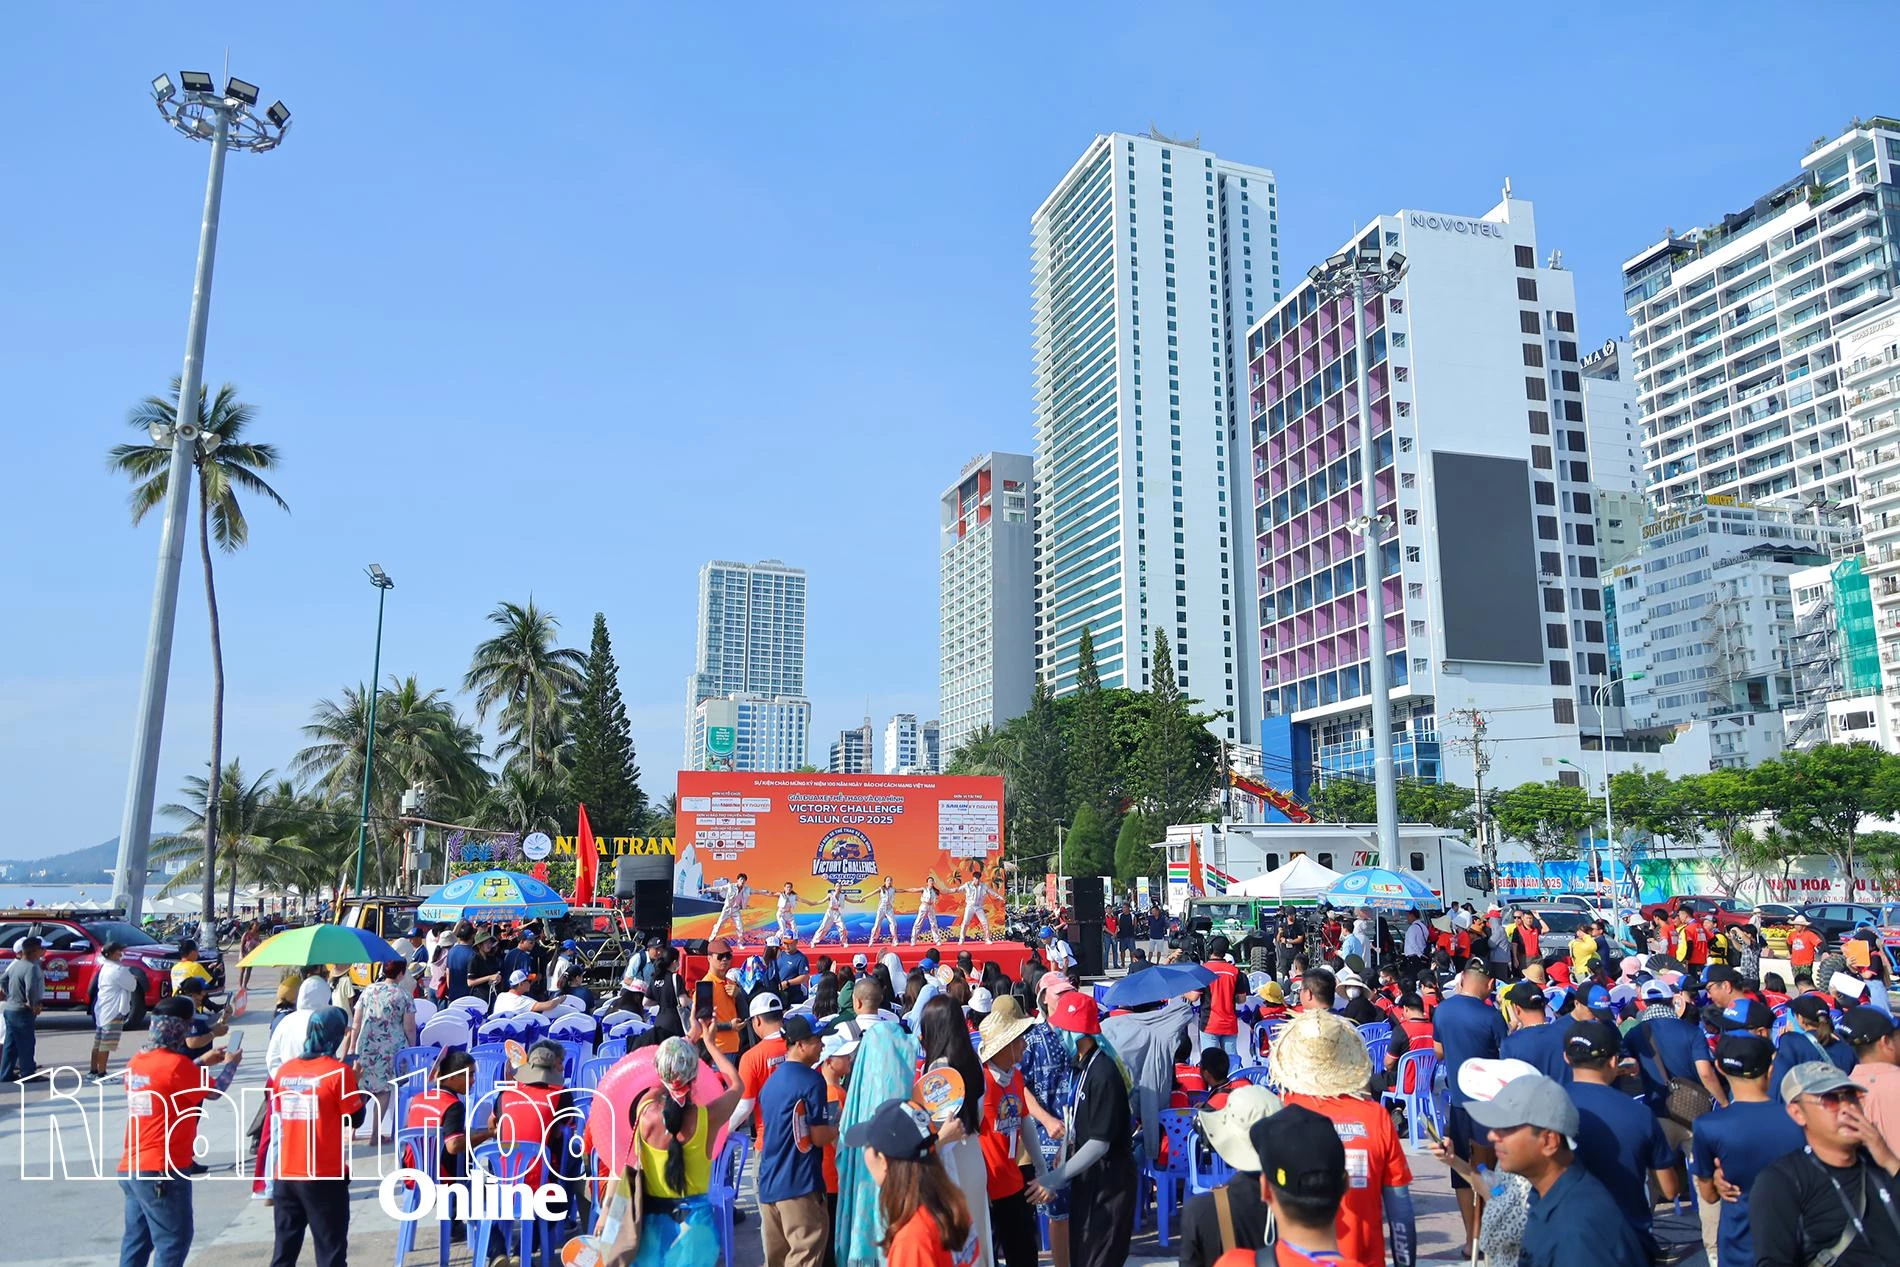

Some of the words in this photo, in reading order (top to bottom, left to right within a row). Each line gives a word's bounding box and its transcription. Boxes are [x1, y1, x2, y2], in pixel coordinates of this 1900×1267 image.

[1410, 213, 1502, 238] NOVOTEL
[1642, 522, 1662, 539] SUN
[1662, 512, 1687, 532] CITY
[788, 804, 838, 812] VICTORY
[840, 805, 903, 814] CHALLENGE
[799, 815, 840, 823] SAILUN
[555, 836, 608, 855] NA
[1352, 851, 1380, 866] KT
[842, 859, 877, 874] CHALLENGE
[1498, 874, 1518, 888] BIỂN
[1520, 875, 1538, 888] NĂM
[422, 908, 441, 919] SKH
